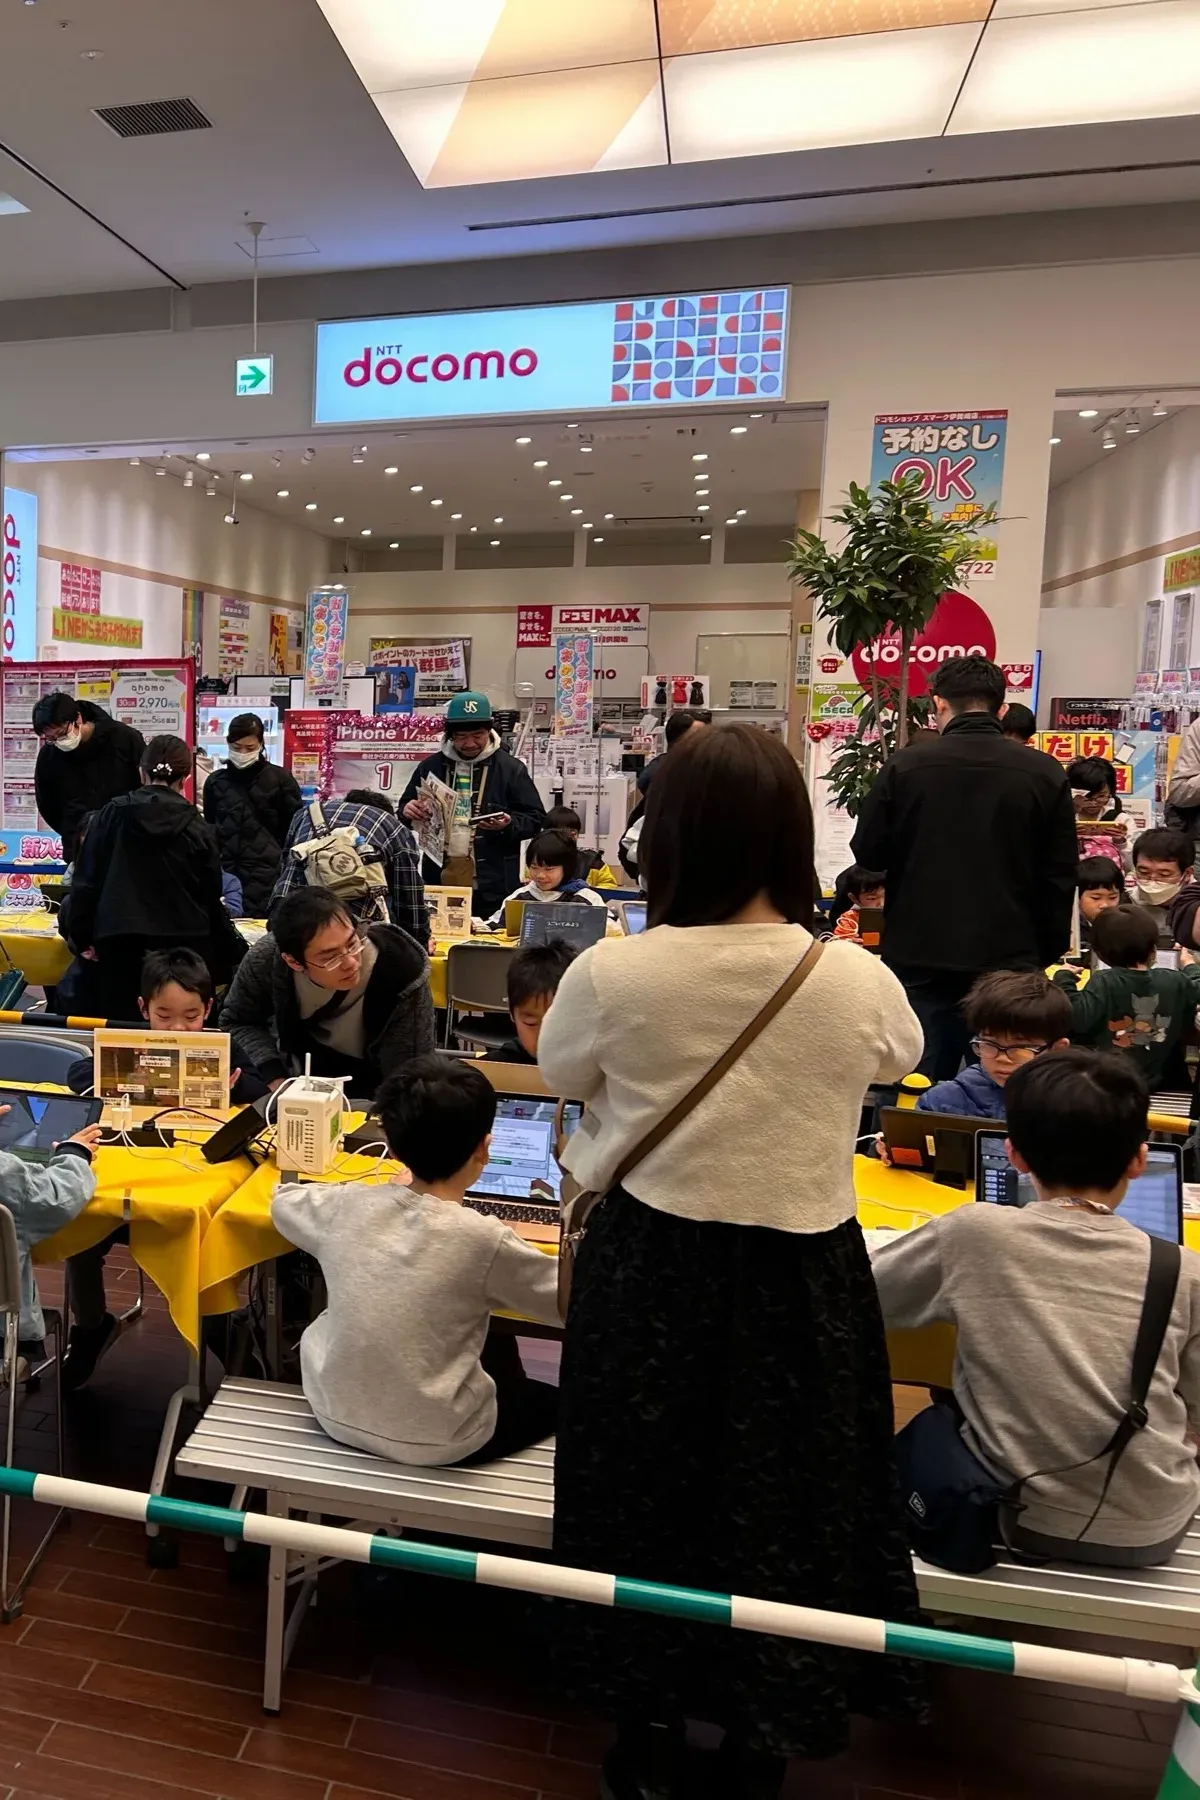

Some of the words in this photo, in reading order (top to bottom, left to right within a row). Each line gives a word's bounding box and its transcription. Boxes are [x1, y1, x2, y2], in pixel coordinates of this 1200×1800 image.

[376, 345, 402, 355] NTT
[344, 347, 538, 387] docomo
[875, 415, 920, 423] ドコモショップ
[882, 424, 999, 454] 予約なし
[891, 456, 976, 501] OK
[4, 514, 20, 662] doco
[545, 665, 616, 680] dmo
[1058, 714, 1108, 725] Netflix
[337, 726, 396, 740] iPhone
[375, 763, 393, 790] 1
